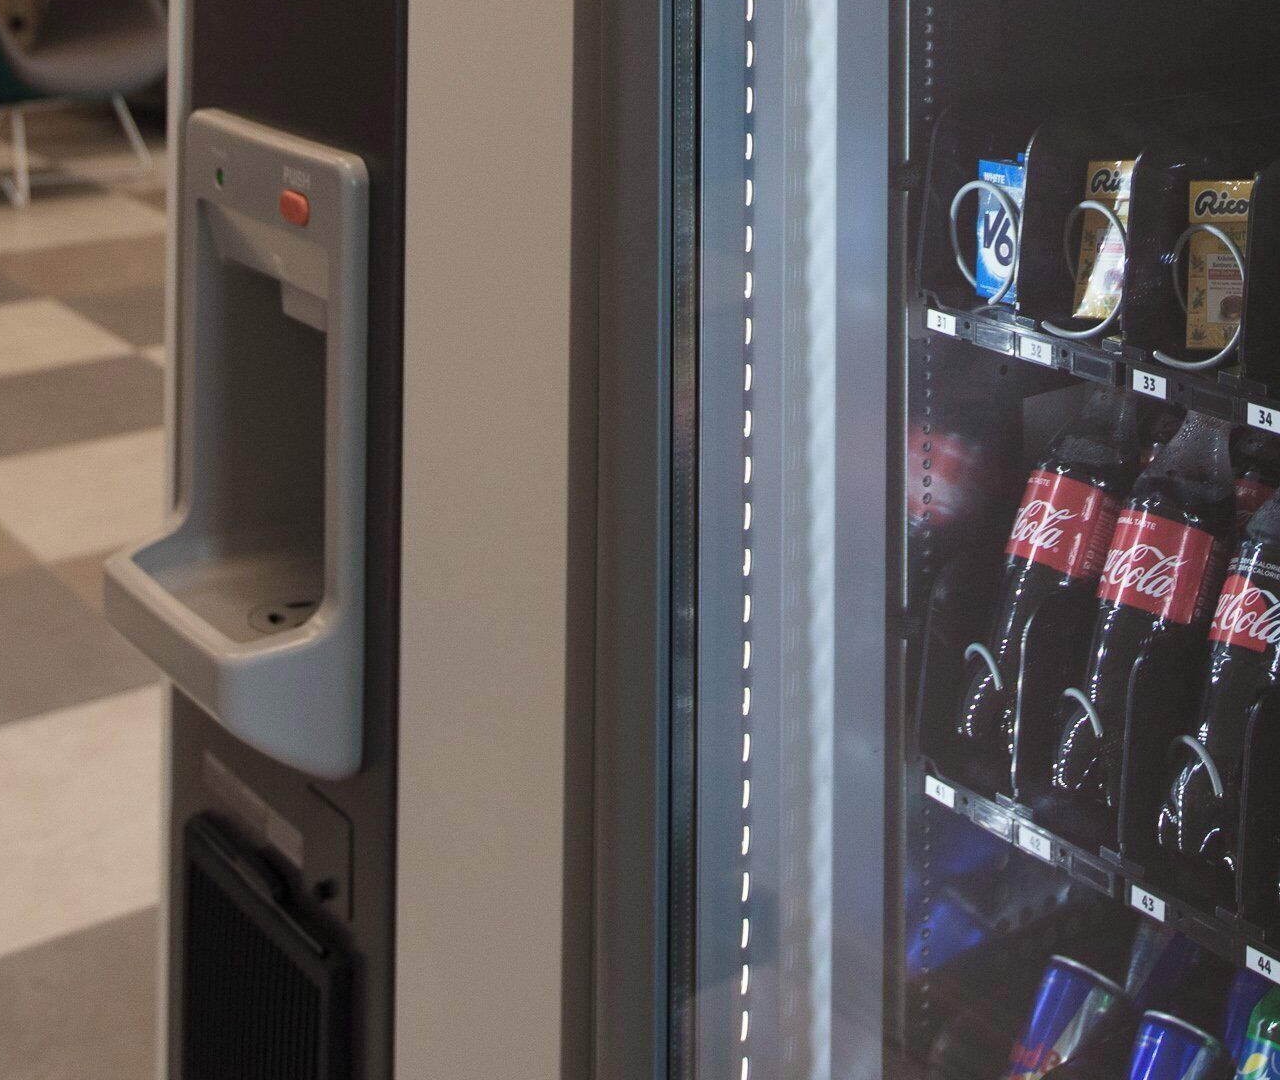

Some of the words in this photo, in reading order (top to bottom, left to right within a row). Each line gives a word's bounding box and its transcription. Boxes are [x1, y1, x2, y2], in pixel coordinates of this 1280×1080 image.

[983, 172, 1006, 185] WHITE
[983, 203, 1013, 267] V6
[937, 315, 947, 329] 31
[1031, 343, 1042, 358] 32
[1143, 375, 1156, 392] 33
[1258, 409, 1272, 427] 34
[1142, 894, 1155, 913] 43
[1257, 956, 1272, 974] 44
